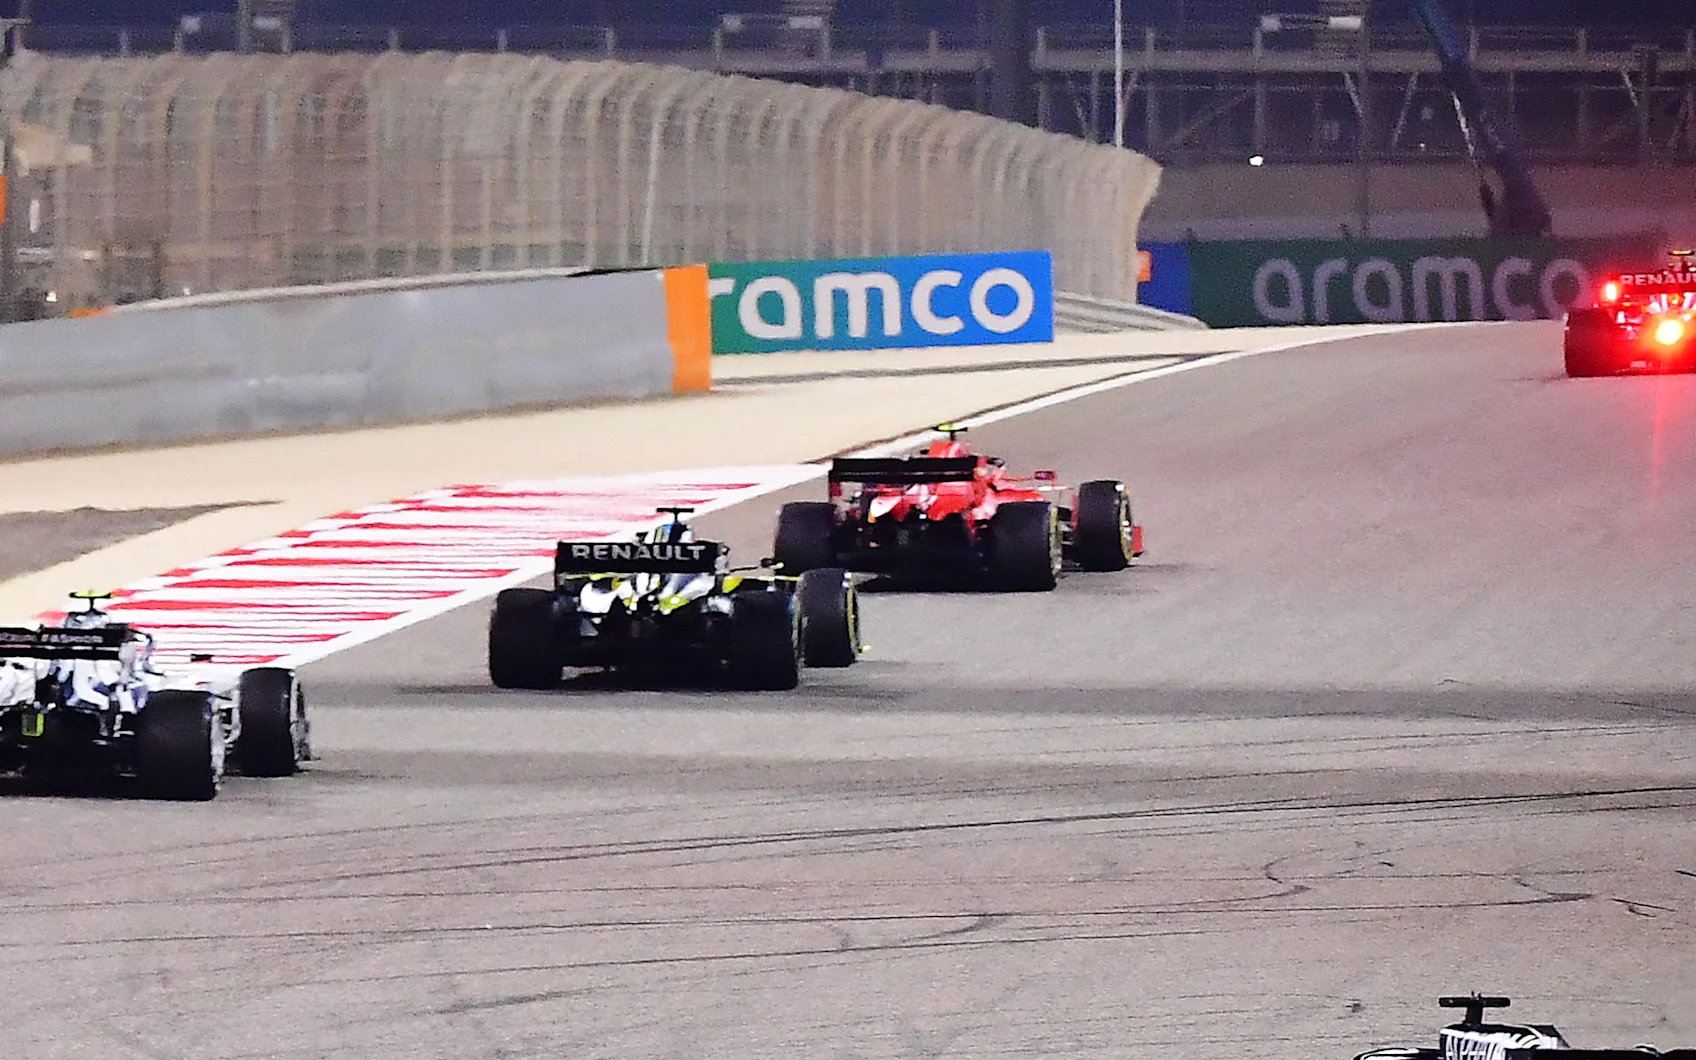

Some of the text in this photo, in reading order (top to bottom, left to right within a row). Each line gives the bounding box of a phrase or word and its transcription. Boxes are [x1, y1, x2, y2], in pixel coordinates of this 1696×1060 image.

[1619, 272, 1696, 287] RENAU
[1254, 255, 1594, 323] aramco
[571, 544, 706, 561] RENAULT
